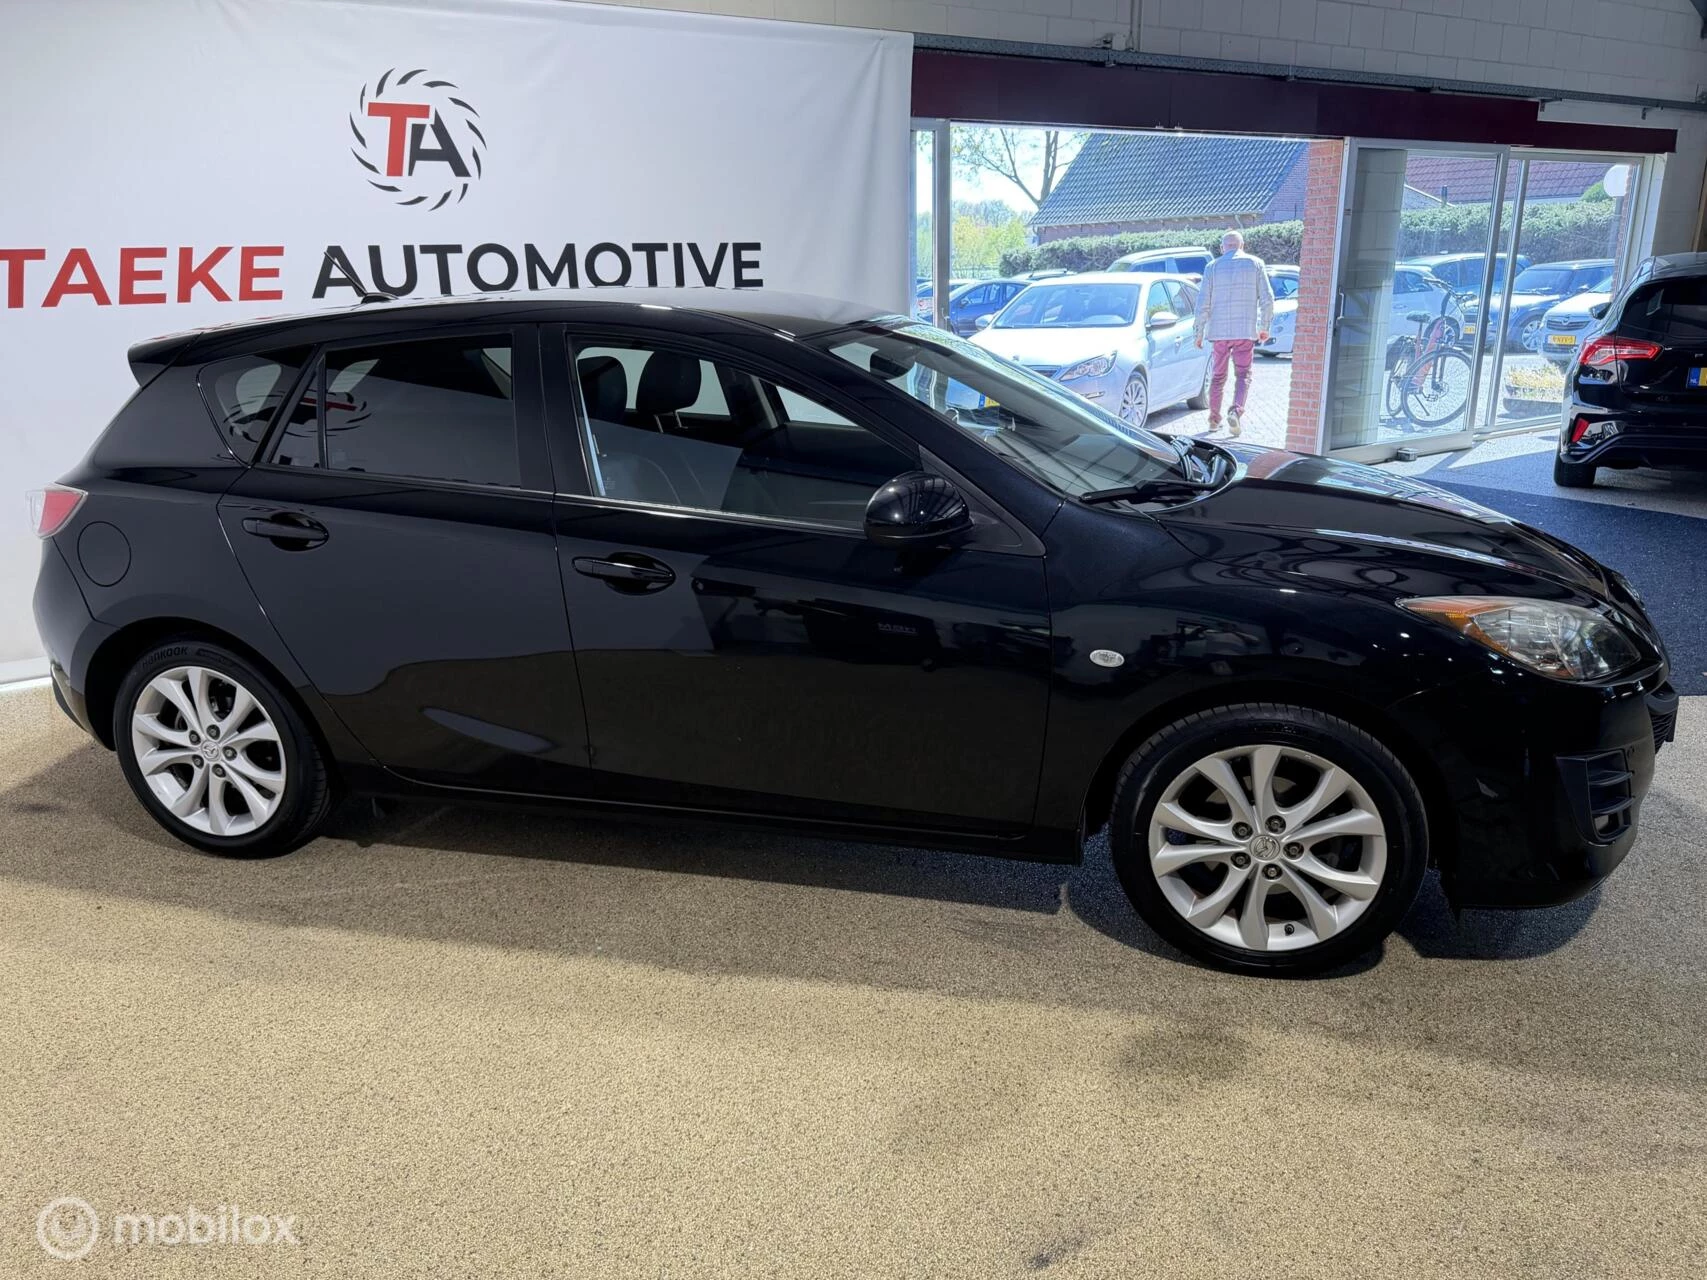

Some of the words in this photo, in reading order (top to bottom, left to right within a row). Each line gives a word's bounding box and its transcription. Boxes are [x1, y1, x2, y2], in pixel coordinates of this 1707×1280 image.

[367, 102, 472, 177] TA
[0, 246, 285, 309] TAEKE
[311, 242, 764, 299] AUTOMOTIVE
